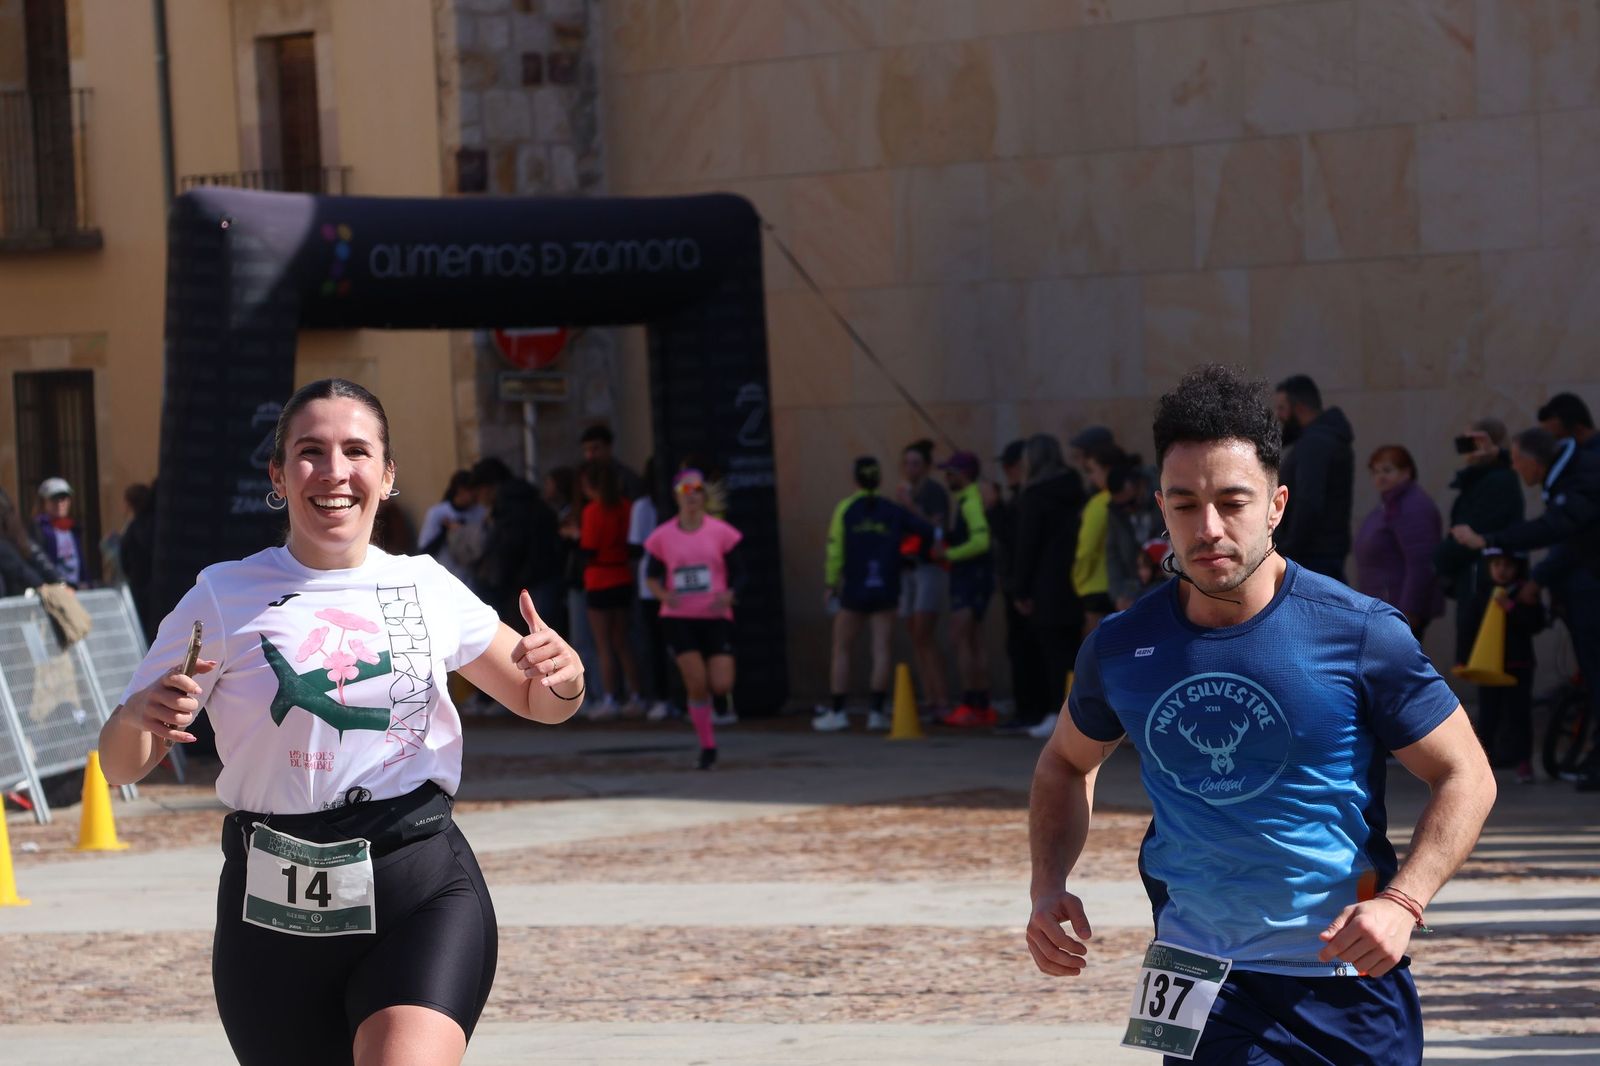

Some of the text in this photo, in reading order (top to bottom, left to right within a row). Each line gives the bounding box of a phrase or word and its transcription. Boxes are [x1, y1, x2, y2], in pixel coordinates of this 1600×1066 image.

[368, 242, 535, 279] alimentos
[571, 238, 702, 274] zamora
[1154, 680, 1276, 735] MUY SILVESTRE
[1204, 705, 1221, 713] XIII
[1199, 775, 1246, 793] Codesal
[281, 864, 332, 908] 14
[1139, 971, 1195, 1021] 137
